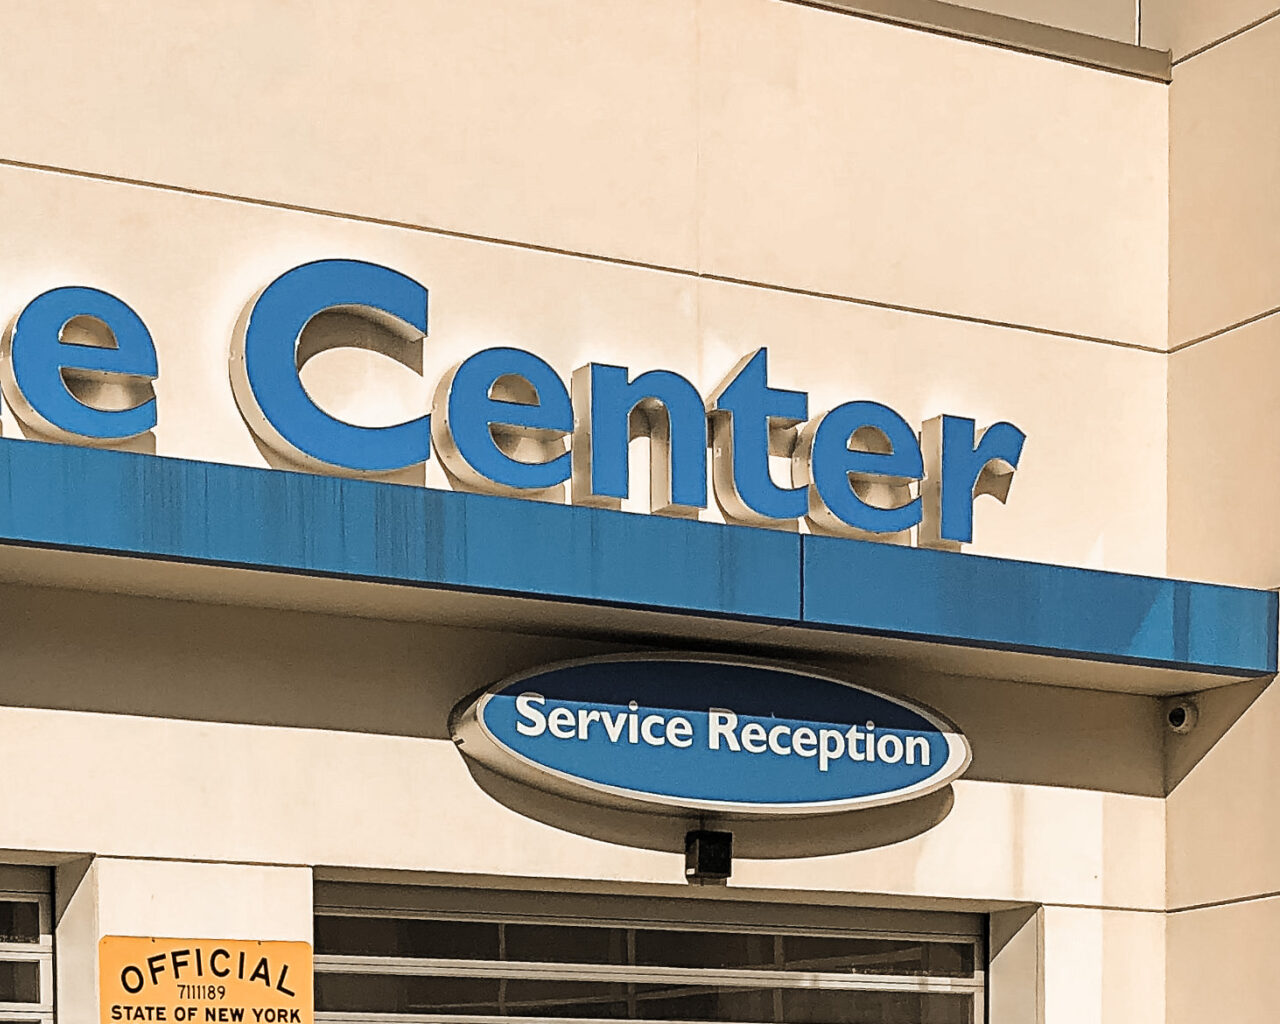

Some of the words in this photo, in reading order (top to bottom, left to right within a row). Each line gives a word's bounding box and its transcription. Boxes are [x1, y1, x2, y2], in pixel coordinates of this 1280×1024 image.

[234, 258, 1027, 544] Center
[515, 692, 694, 748] Service
[709, 708, 931, 771] Reception
[120, 948, 296, 998] OFFICIAL
[176, 984, 226, 1000] 7111189
[111, 1005, 167, 1021] STATE
[174, 1006, 198, 1022] OF
[205, 1007, 245, 1022] NEW
[252, 1008, 301, 1023] YORK
